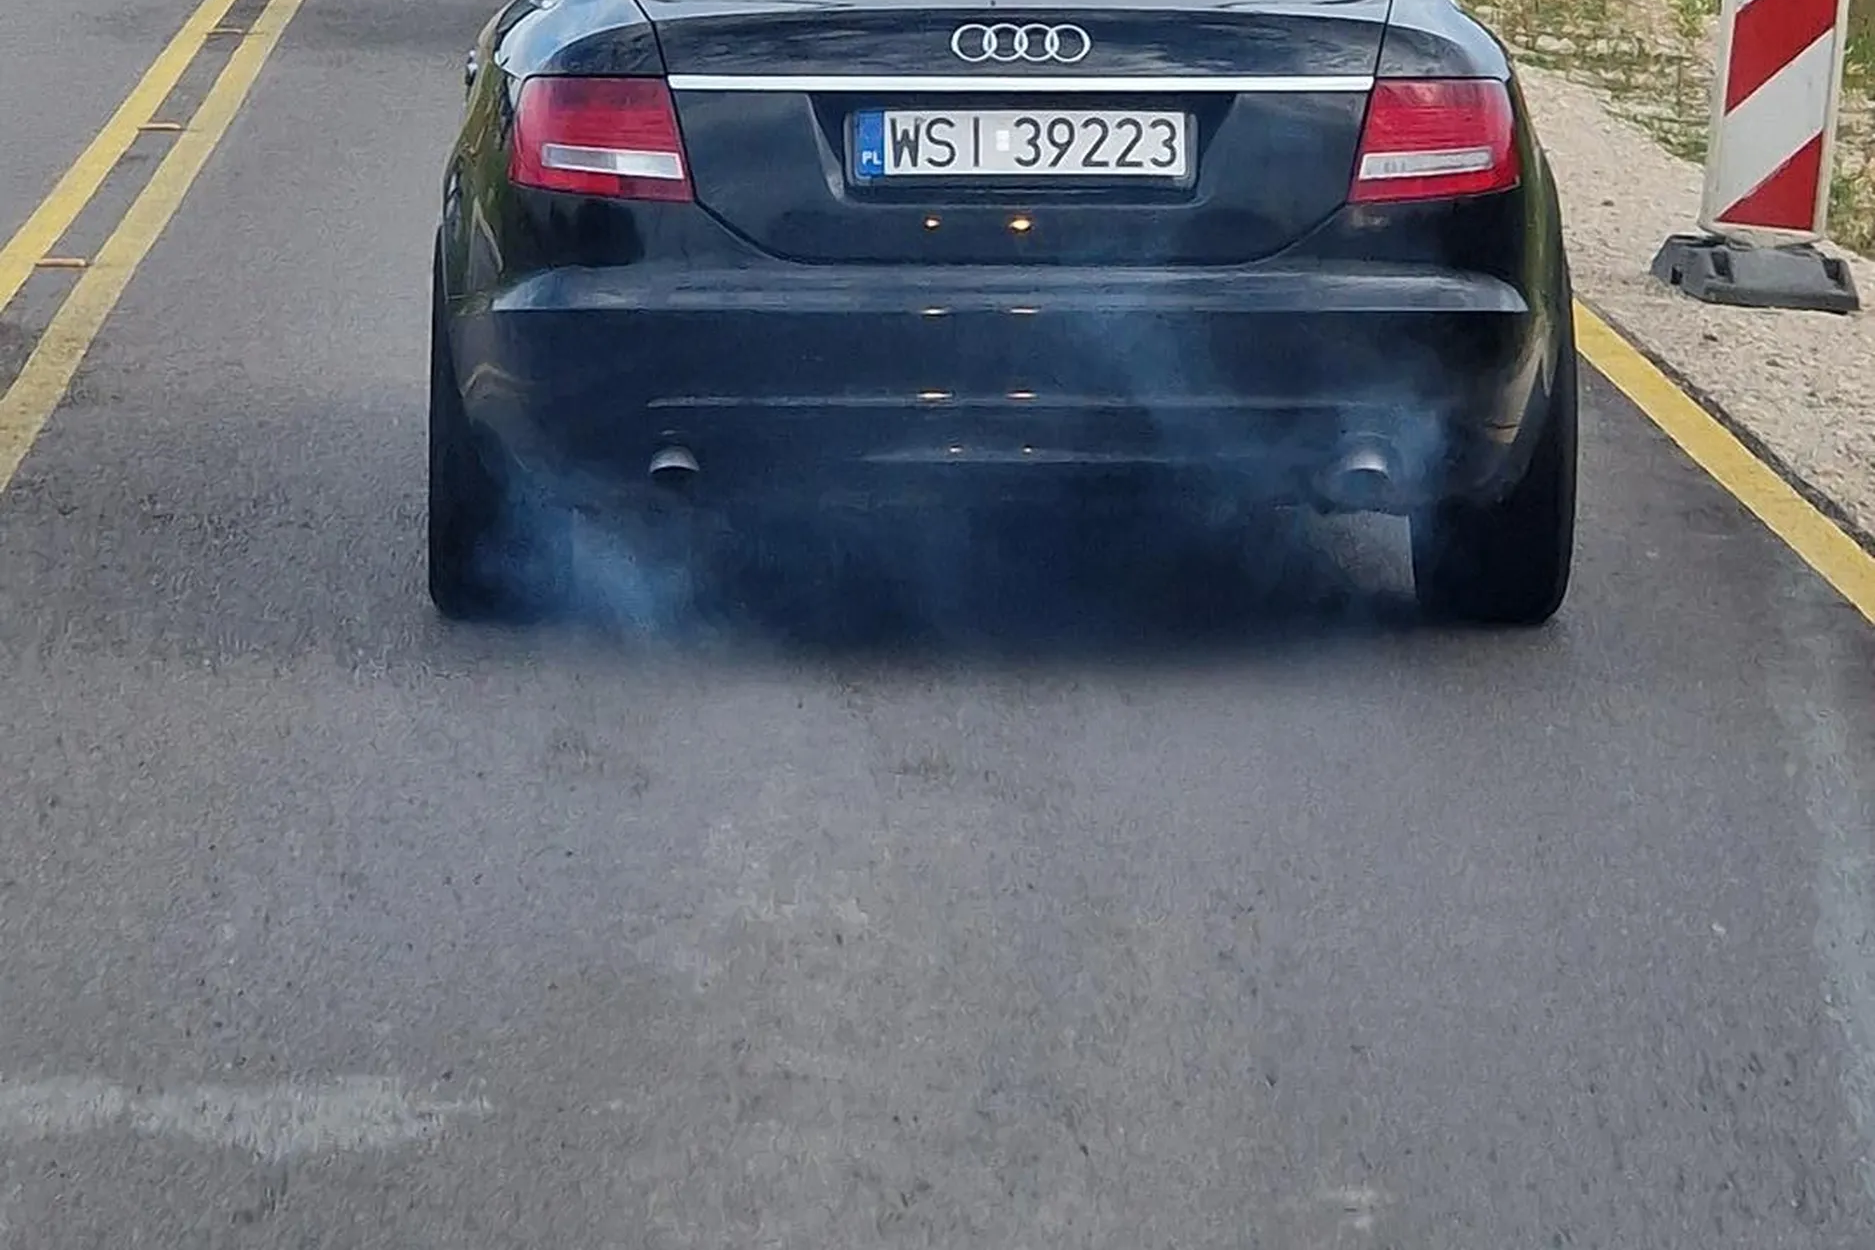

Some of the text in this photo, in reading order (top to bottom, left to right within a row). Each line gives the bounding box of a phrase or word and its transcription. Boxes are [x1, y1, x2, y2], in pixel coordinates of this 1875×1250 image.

[862, 150, 882, 166] PL
[889, 116, 1178, 168] WSI 39223
